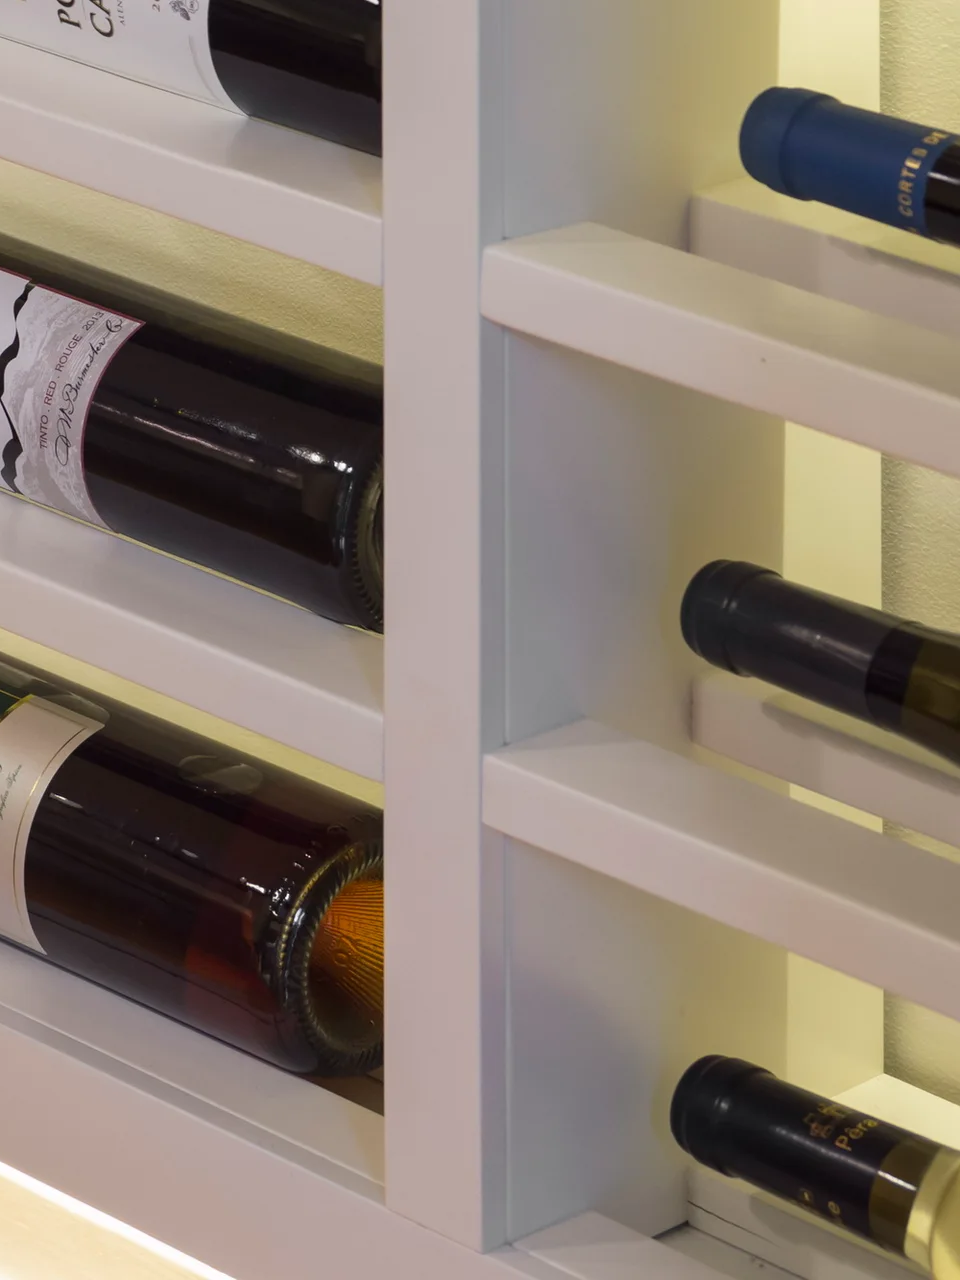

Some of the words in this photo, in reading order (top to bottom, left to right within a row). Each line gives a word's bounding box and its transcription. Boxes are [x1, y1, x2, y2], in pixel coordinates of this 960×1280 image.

[81, 311, 105, 332] 2013
[55, 333, 83, 373] ROUGE
[43, 379, 57, 406] RED
[39, 414, 50, 450] TINTO
